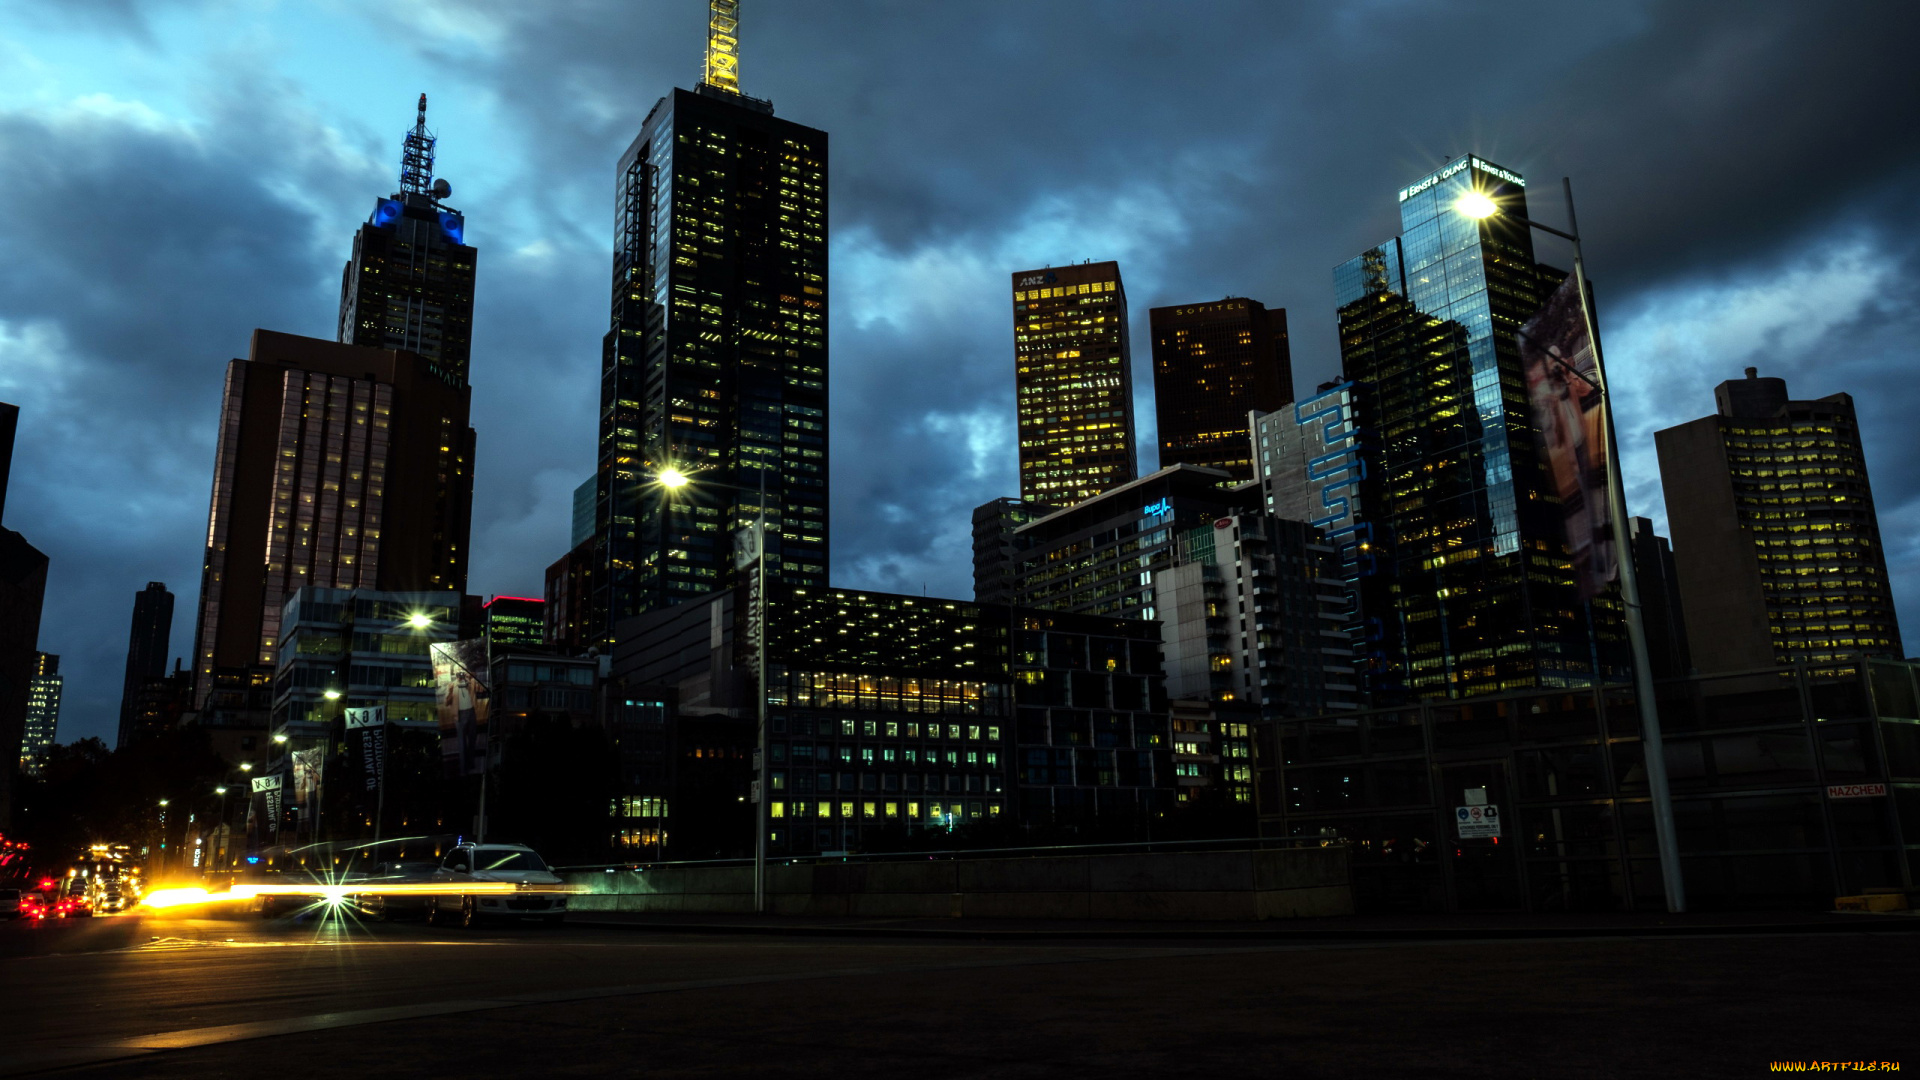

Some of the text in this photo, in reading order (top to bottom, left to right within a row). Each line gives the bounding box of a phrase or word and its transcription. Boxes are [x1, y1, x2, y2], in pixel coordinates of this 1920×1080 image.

[1409, 178, 1432, 196] ERNST
[1439, 160, 1467, 181] YOUNG
[1481, 161, 1499, 176] ERNST
[1503, 169, 1526, 187] YOUNG
[1020, 275, 1044, 287] ANZ
[1176, 303, 1245, 316] SOFITEL
[429, 361, 463, 389] HYATT
[1144, 503, 1160, 515] Bupa
[1829, 785, 1885, 796] HAZCHEM
